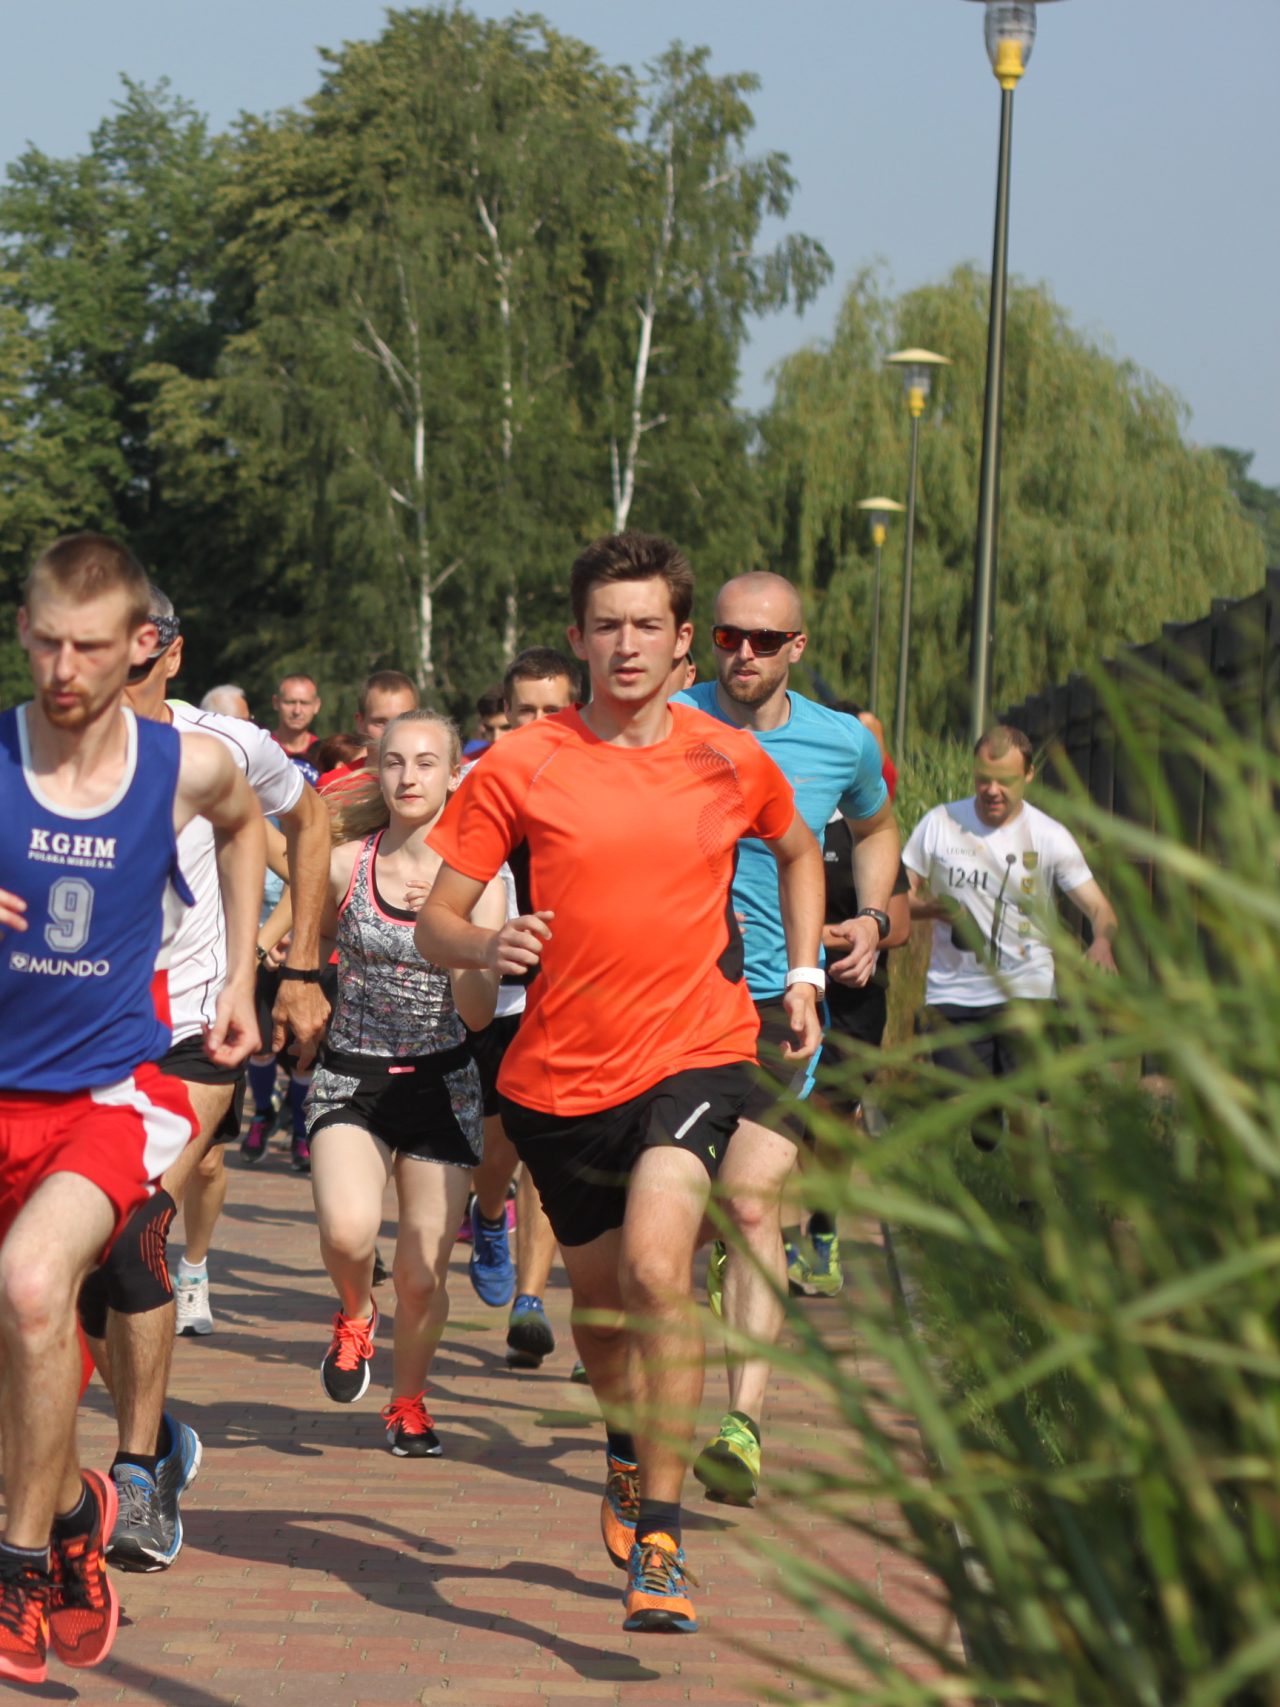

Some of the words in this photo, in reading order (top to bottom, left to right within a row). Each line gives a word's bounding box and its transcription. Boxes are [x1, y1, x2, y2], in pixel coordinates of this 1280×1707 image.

[29, 828, 117, 859] KGHM
[949, 866, 989, 890] 1241
[44, 876, 95, 953] 9
[29, 956, 110, 977] MUNDO
